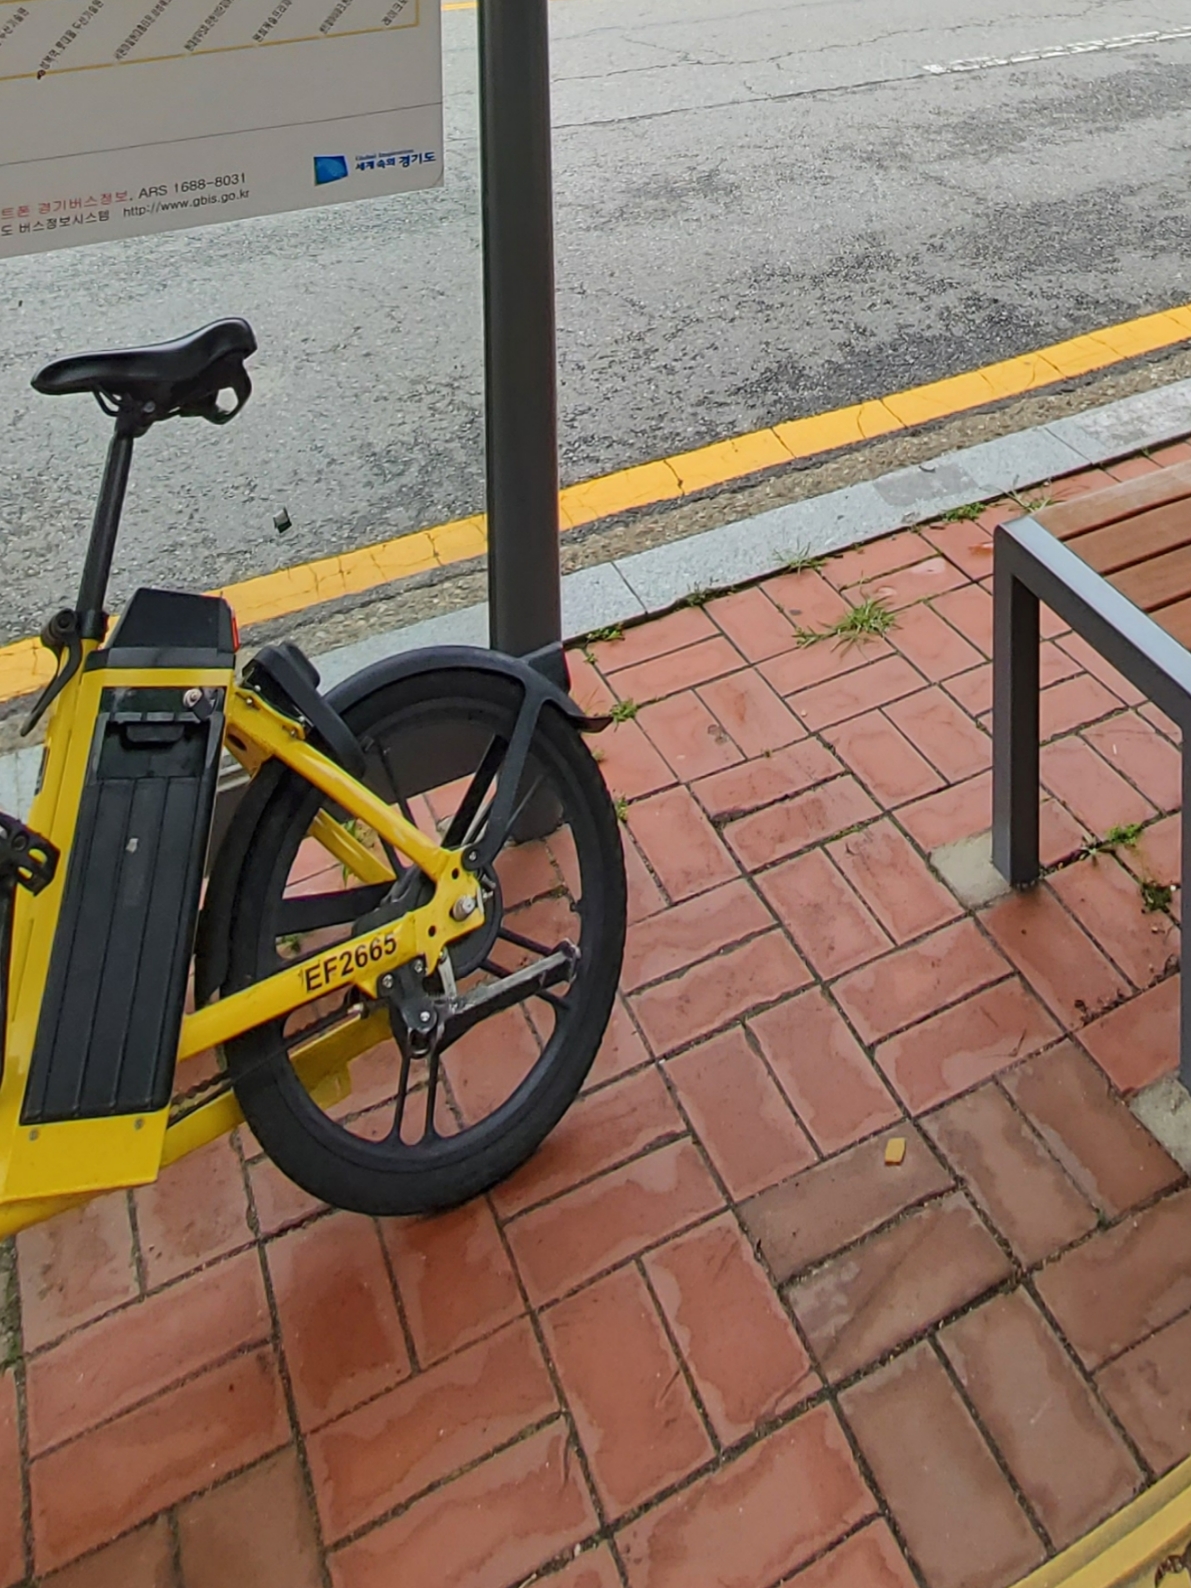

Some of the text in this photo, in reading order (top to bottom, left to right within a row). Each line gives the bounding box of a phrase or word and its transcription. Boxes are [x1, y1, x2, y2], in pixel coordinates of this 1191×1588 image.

[399, 152, 437, 168] 경기도
[138, 185, 168, 199] ARS
[174, 172, 247, 193] 1688-8031
[19, 209, 110, 234] 버스정보시스템
[123, 188, 250, 218] http://www.gbis.go.kr
[305, 933, 397, 992] EF2665
